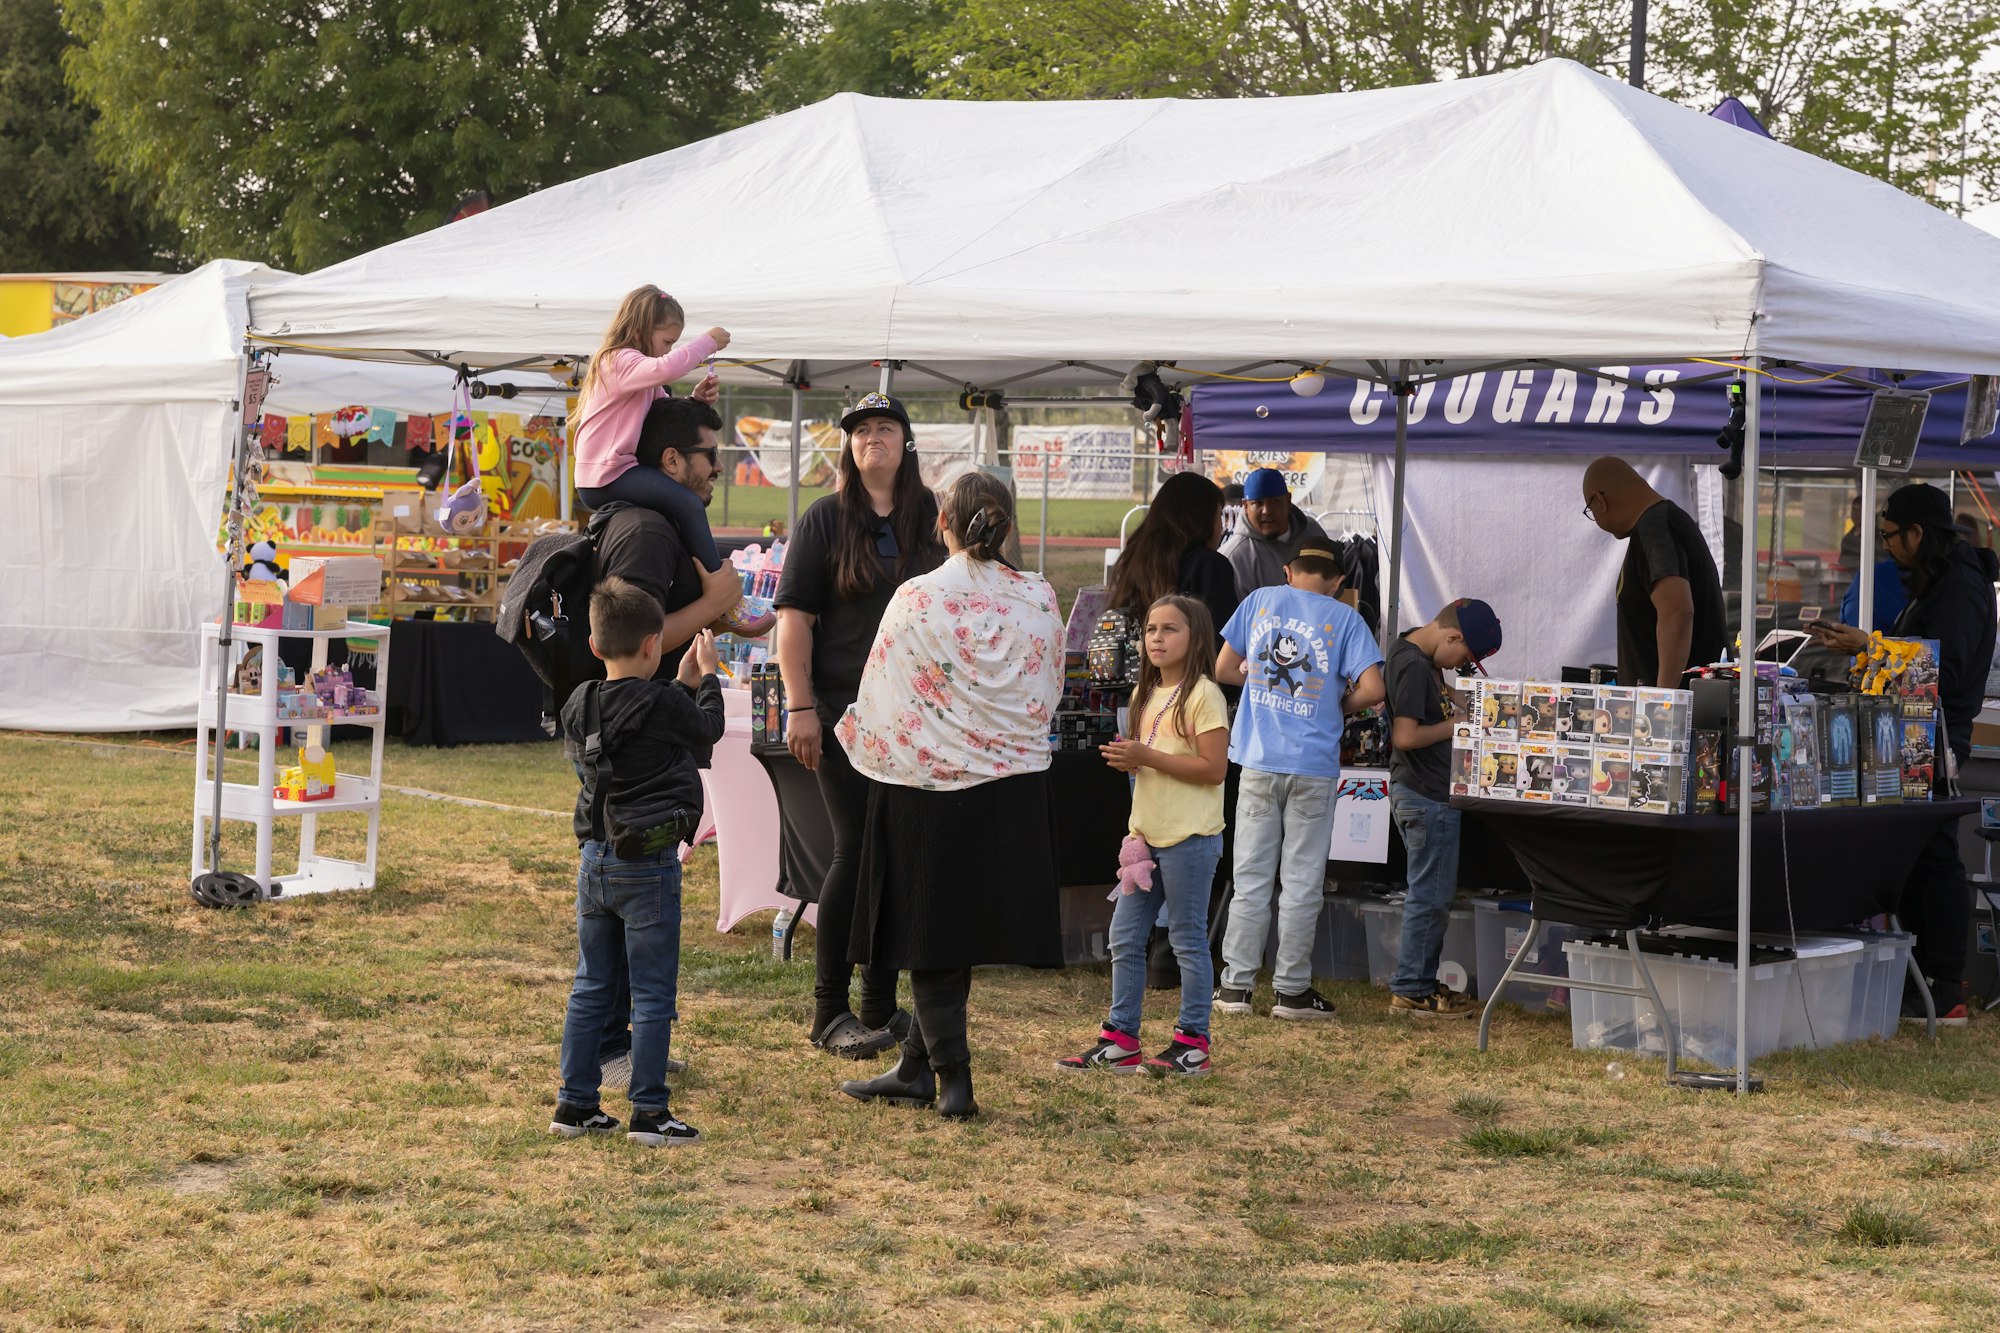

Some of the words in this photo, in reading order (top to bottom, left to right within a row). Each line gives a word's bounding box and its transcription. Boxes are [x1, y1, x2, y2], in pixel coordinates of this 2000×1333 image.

[248, 393, 258, 405] $5
[1349, 366, 1682, 426] COUGARS
[511, 440, 546, 466] CO
[1249, 451, 1288, 461] FRIES
[1283, 617, 1315, 639] ALL
[1250, 688, 1274, 706] ELIX
[1270, 695, 1294, 713] THE
[1293, 702, 1314, 717] CAT
[1903, 705, 1934, 718] ONE
